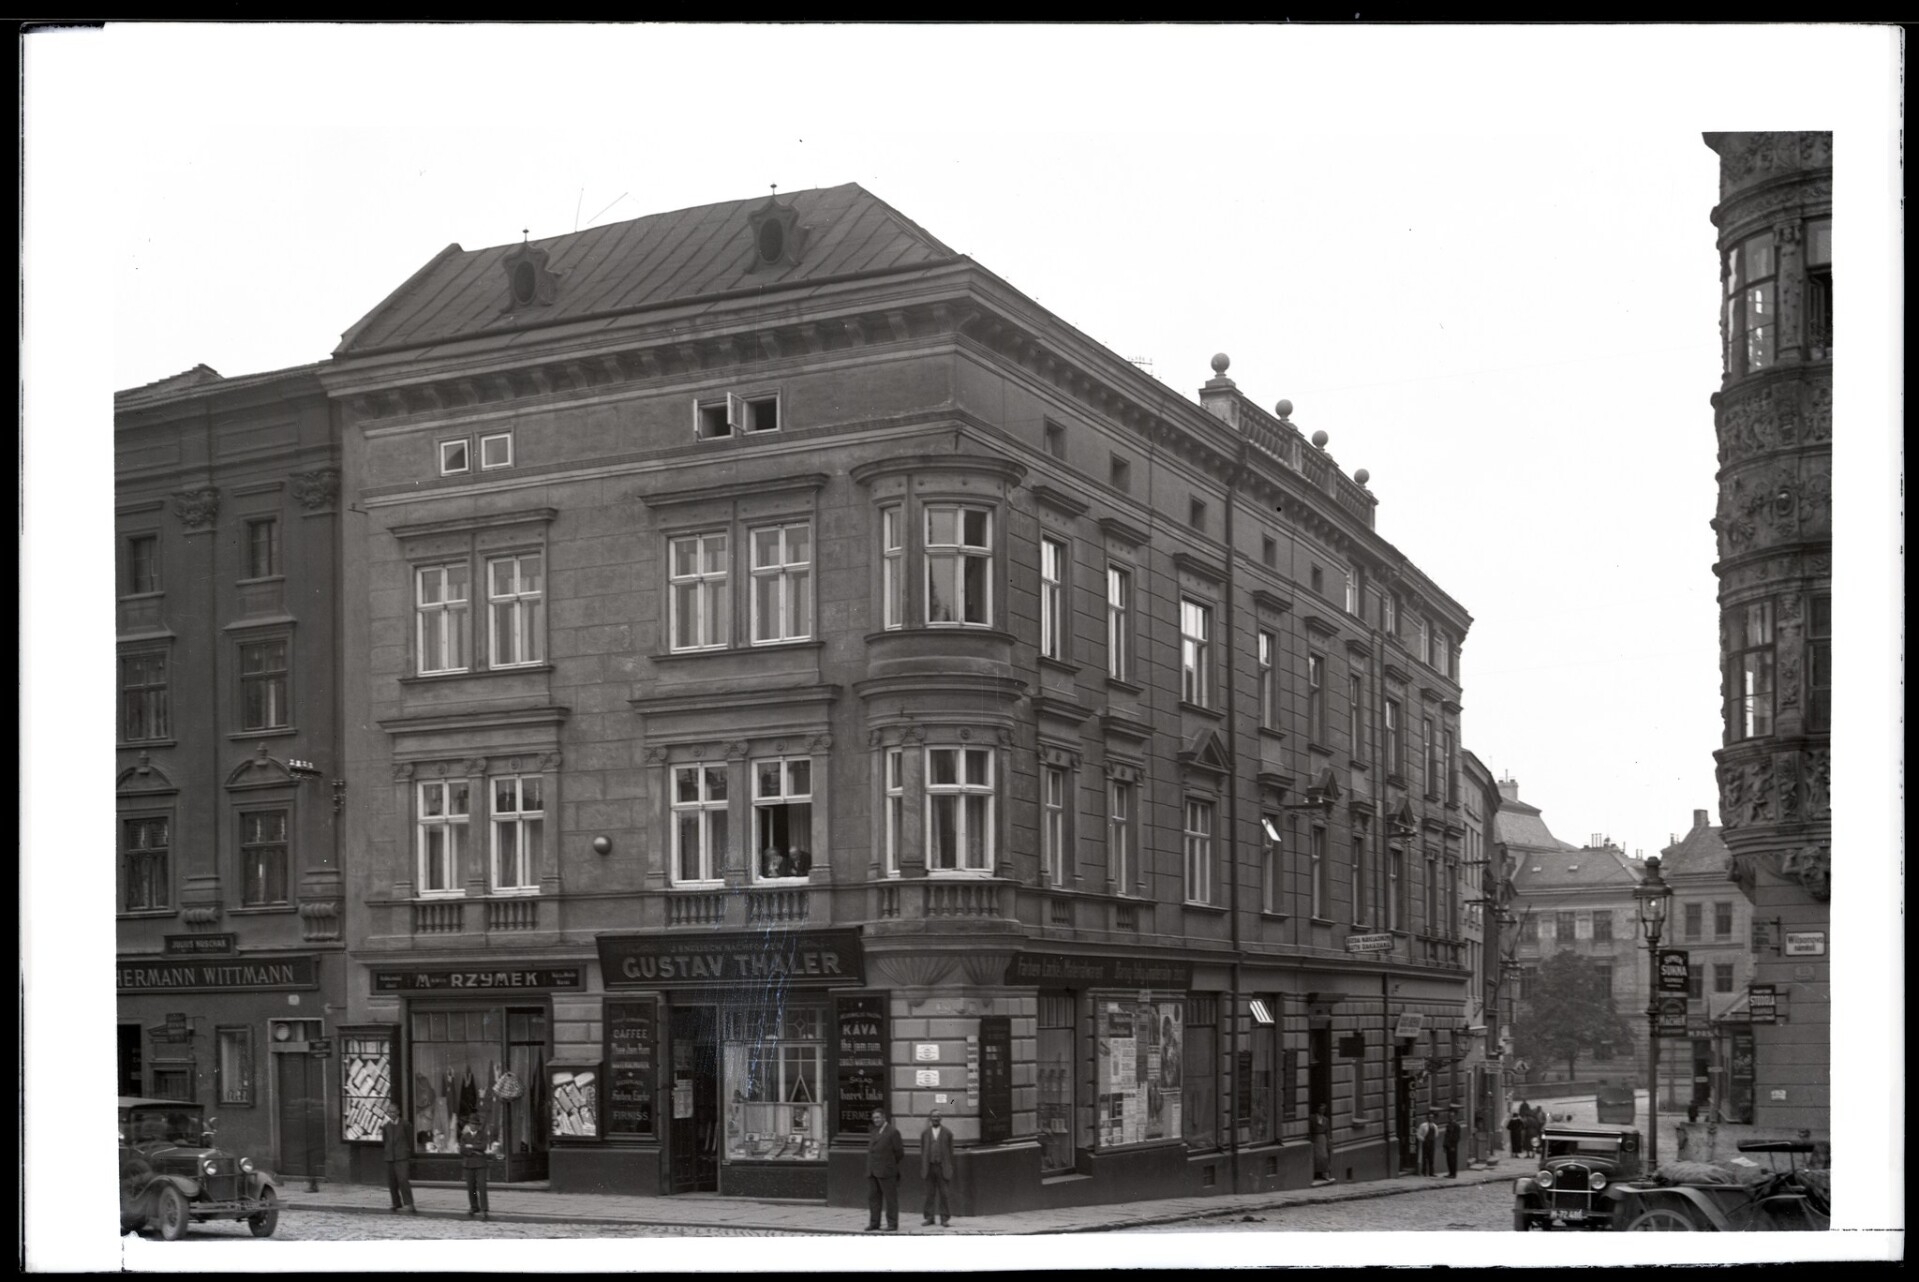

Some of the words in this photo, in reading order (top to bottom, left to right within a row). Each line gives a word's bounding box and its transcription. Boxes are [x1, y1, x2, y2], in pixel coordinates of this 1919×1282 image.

[623, 955, 725, 978] GUSTAV
[734, 952, 843, 977] THALER
[203, 965, 294, 985] WITTMANN
[451, 972, 538, 987] RZYMEK
[613, 1029, 648, 1039] CAFFEE
[613, 1111, 649, 1120] FIRNISS
[841, 1110, 873, 1121] FERME
